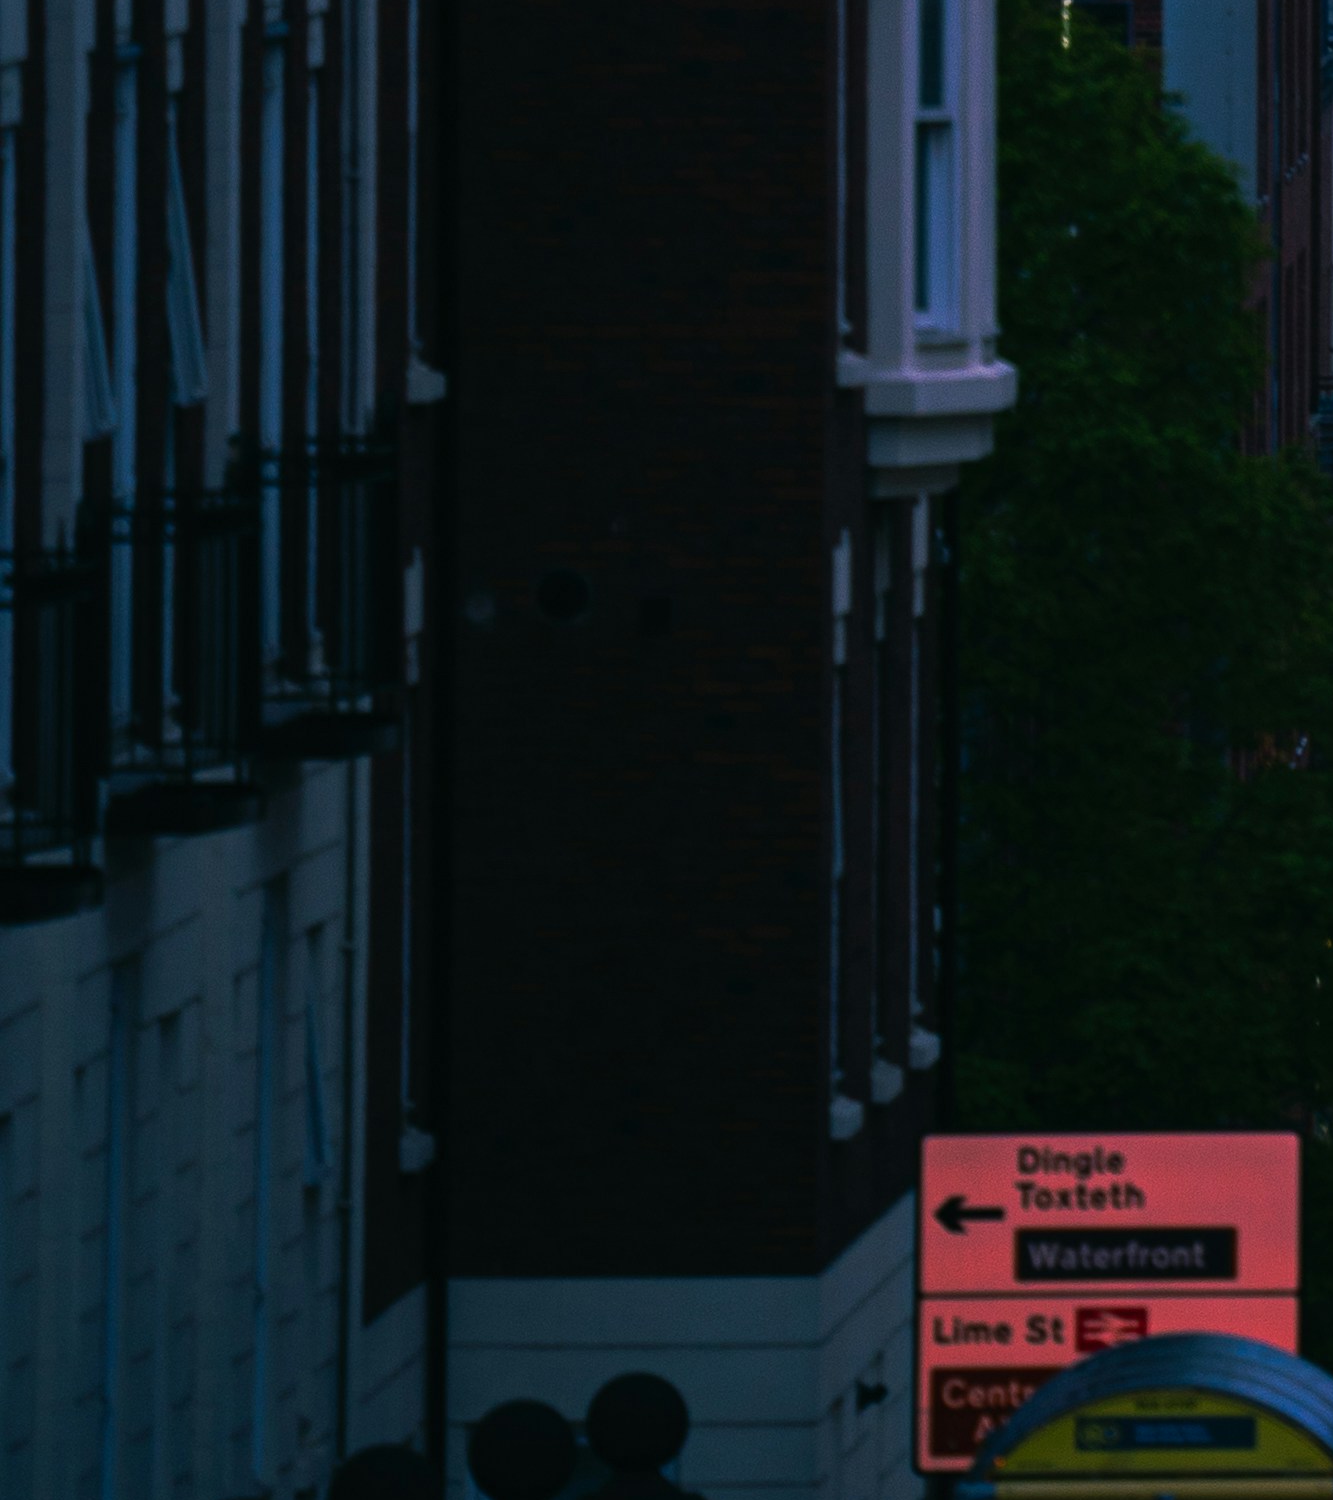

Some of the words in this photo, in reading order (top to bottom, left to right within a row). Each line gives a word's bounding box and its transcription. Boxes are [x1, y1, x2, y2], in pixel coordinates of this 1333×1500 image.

[1018, 1146, 1125, 1179] Dingle
[1017, 1182, 1145, 1211] Toxteth
[1027, 1240, 1207, 1271] Waterfront
[934, 1315, 1012, 1346] Lime
[1026, 1314, 1065, 1346] St
